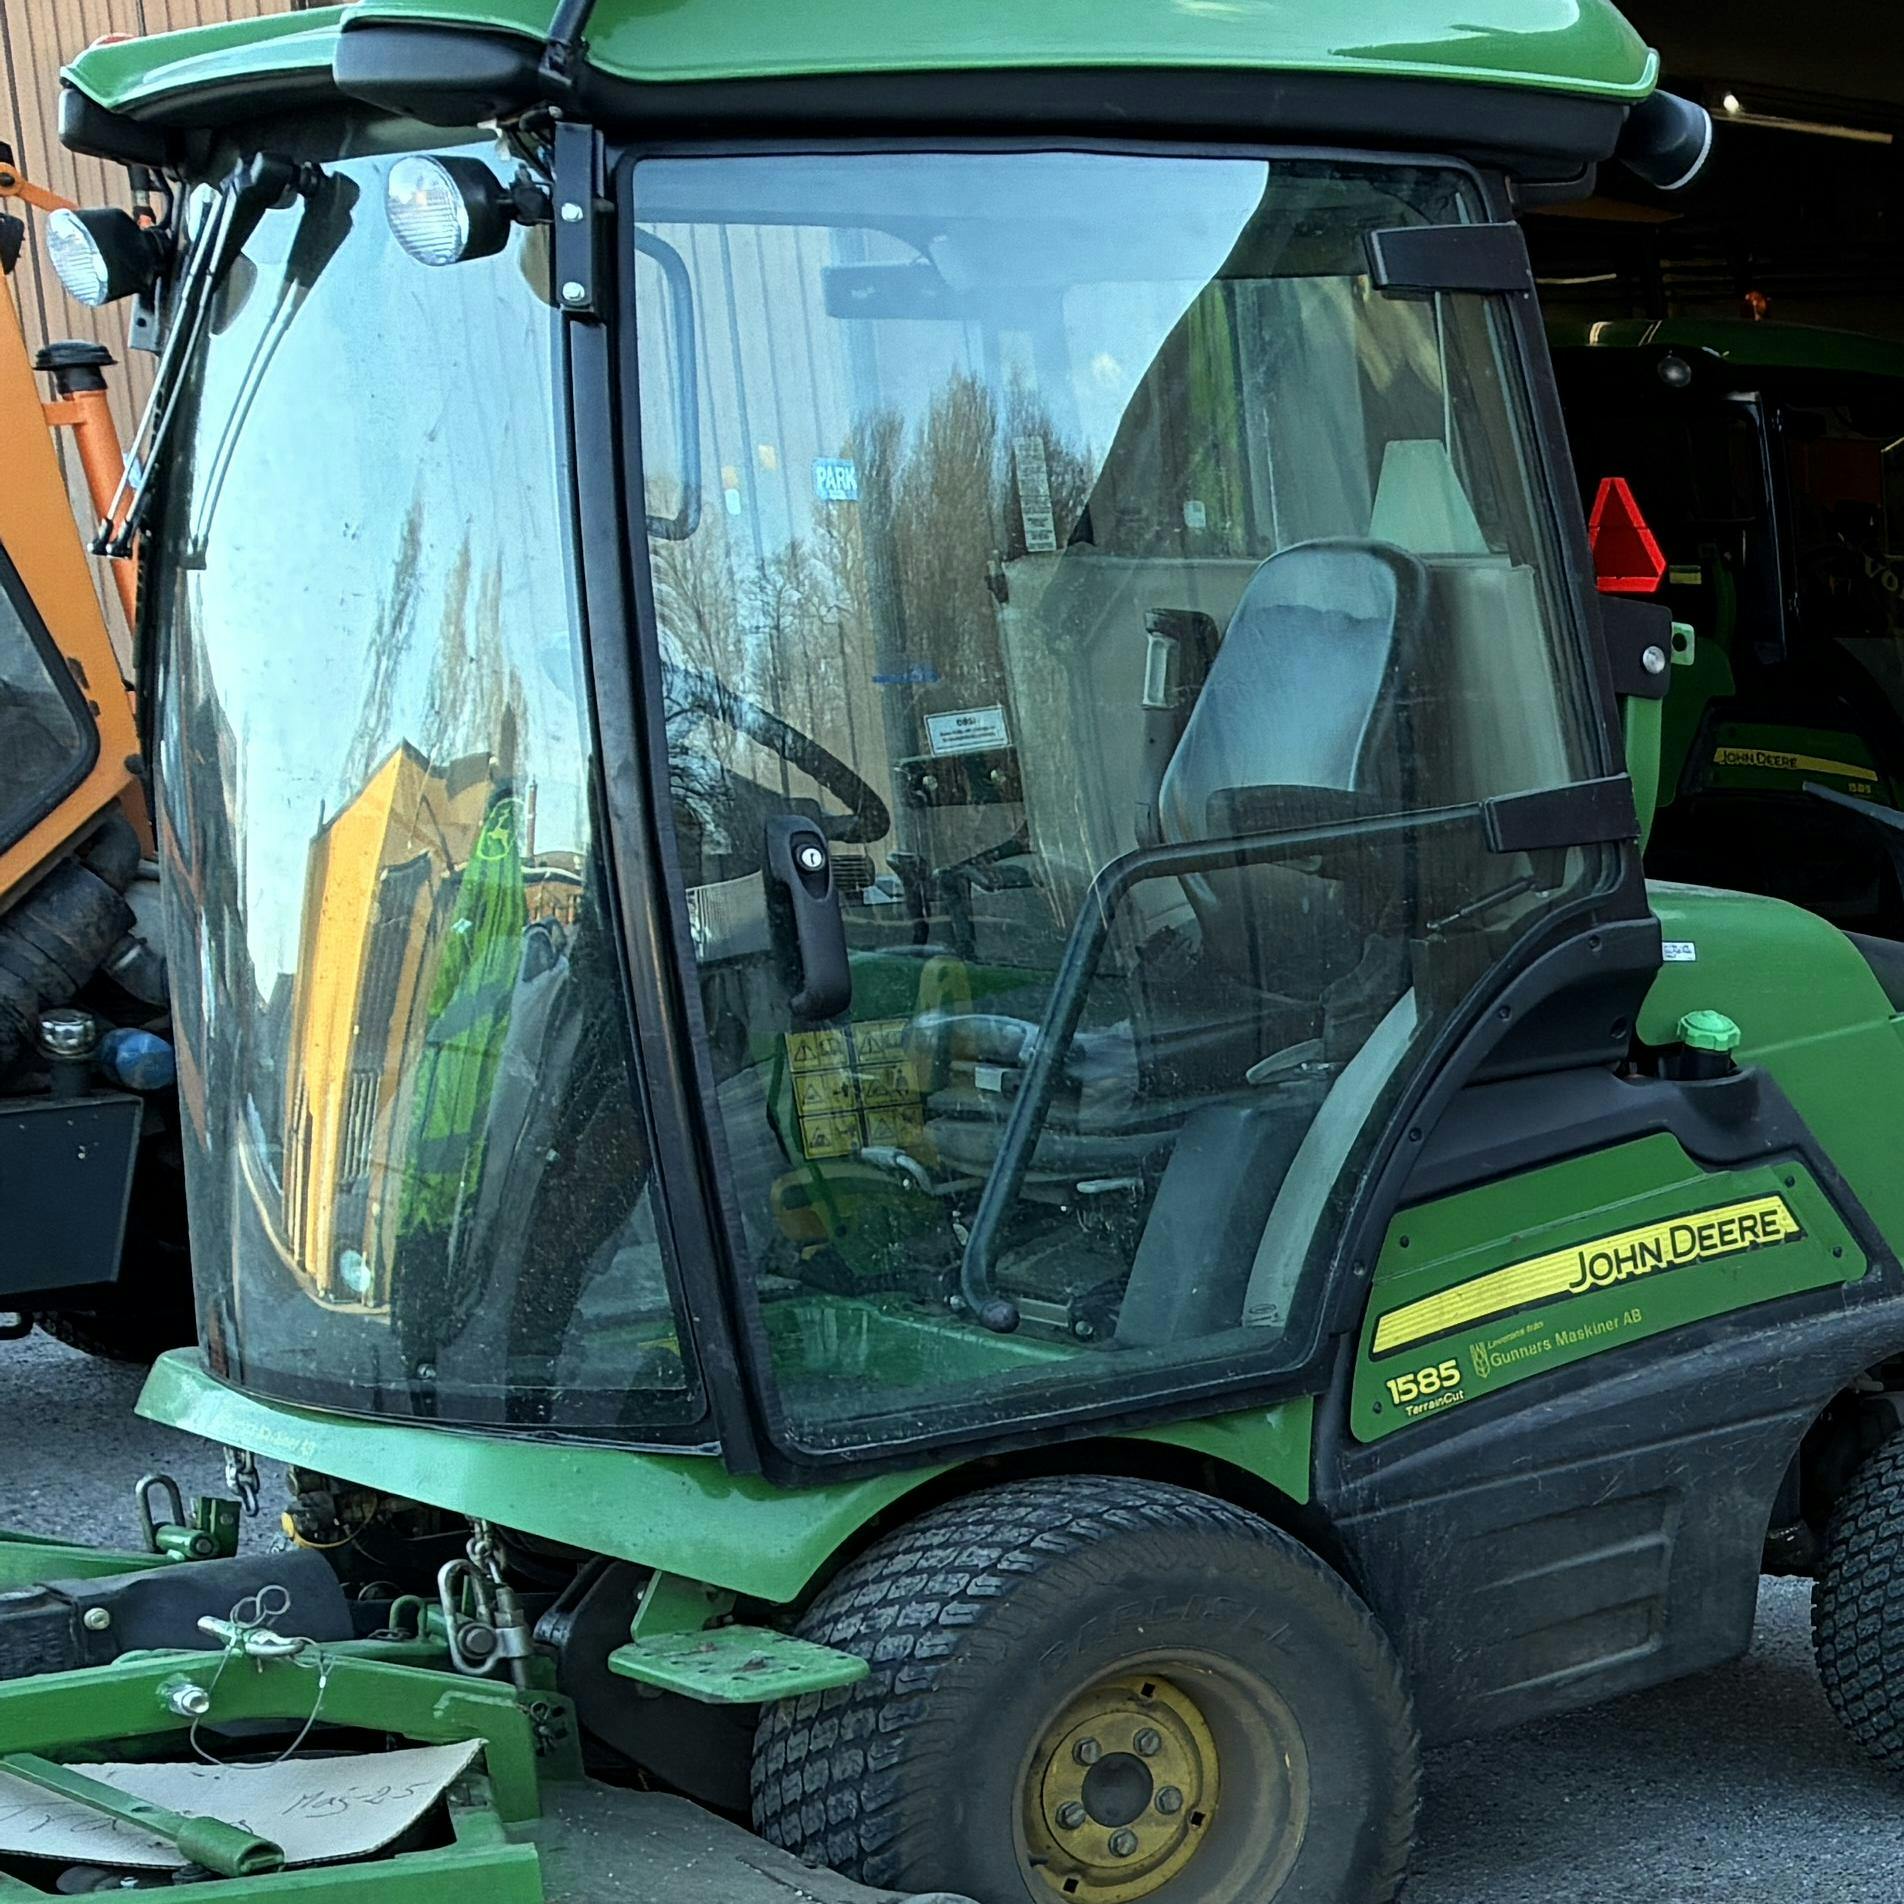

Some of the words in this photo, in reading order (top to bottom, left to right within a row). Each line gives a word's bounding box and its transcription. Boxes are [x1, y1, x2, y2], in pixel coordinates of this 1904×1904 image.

[815, 465, 857, 491] PARK
[1722, 750, 1755, 765] JOHN
[1756, 751, 1798, 768] DEERE
[1569, 1237, 1664, 1290] JOHN
[1669, 1209, 1782, 1259] DEERE
[1490, 1339, 1552, 1368] Gunnars
[1555, 1315, 1619, 1348] Maskiner
[1623, 1308, 1642, 1326] AB
[1386, 1358, 1461, 1406] 1585
[1405, 1390, 1465, 1417] TerrainCut
